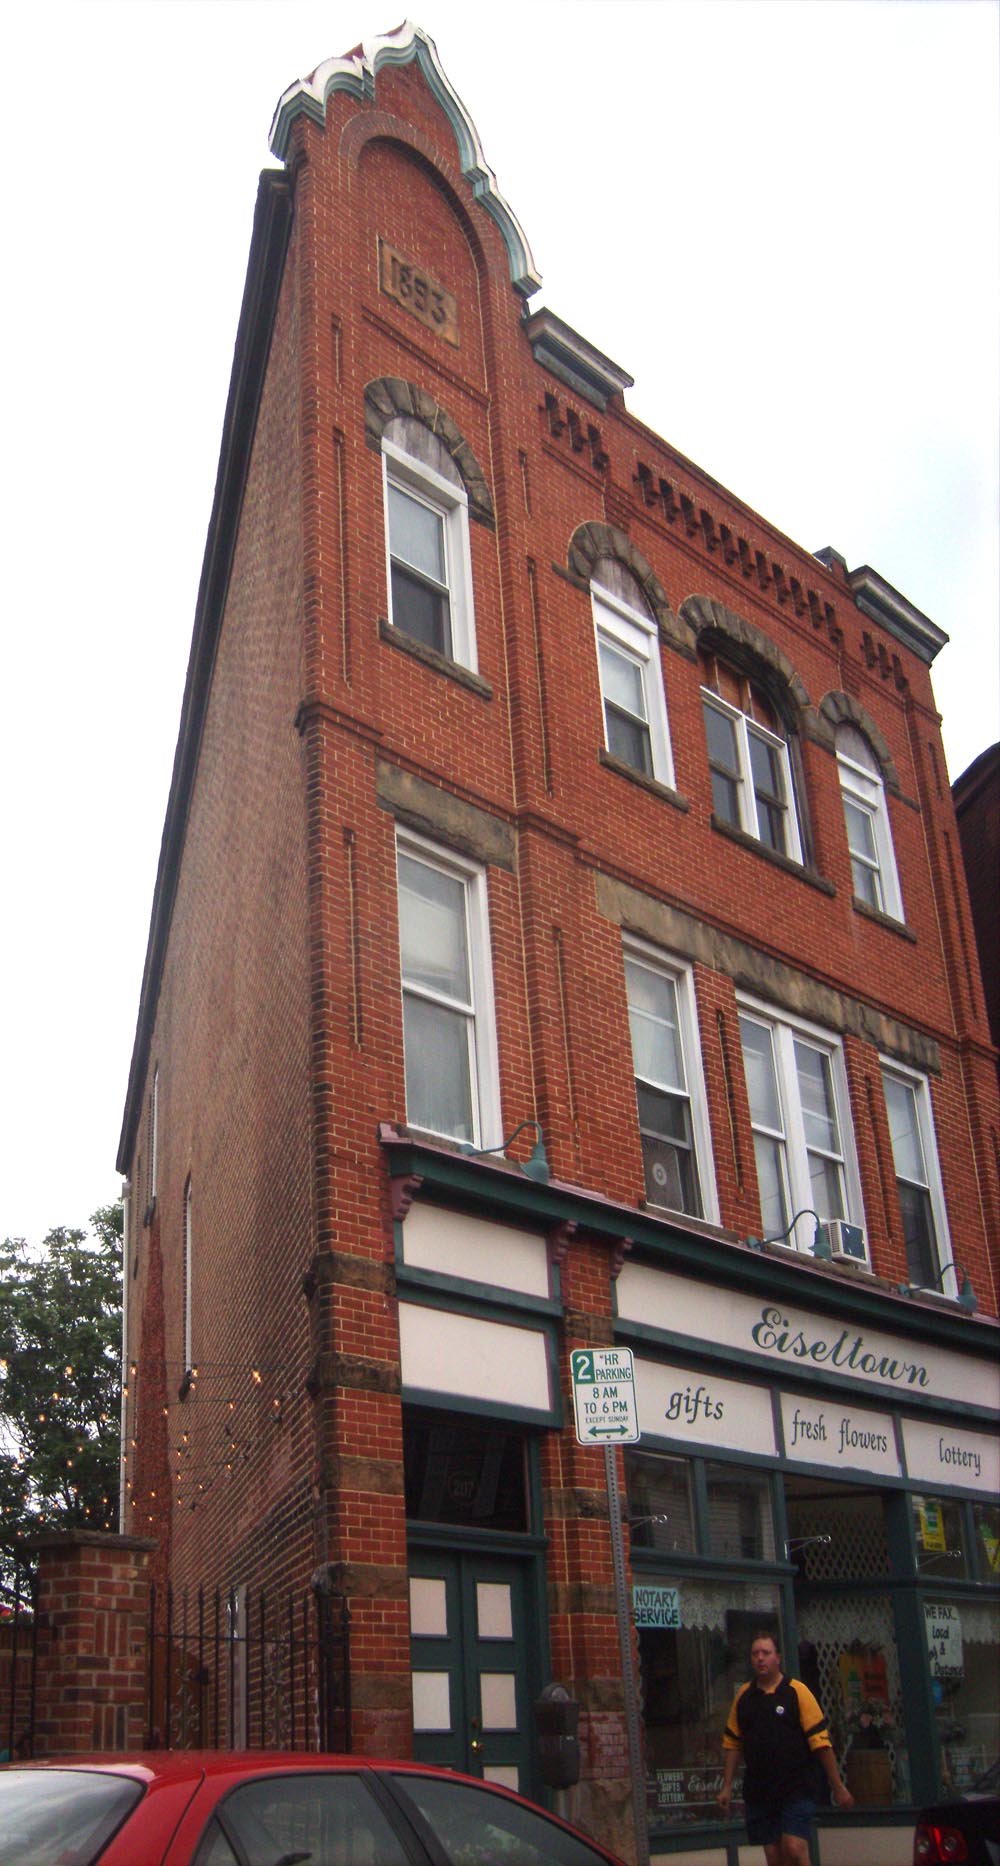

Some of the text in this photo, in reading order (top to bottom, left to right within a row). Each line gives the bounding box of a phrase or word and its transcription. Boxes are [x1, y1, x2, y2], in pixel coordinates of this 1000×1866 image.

[390, 256, 446, 325] 1853
[751, 1307, 930, 1387] Eiseltown
[576, 1355, 592, 1380] 2
[604, 1353, 619, 1366] HR
[595, 1367, 632, 1381] PARKING
[592, 1386, 618, 1399] 8 AM
[584, 1400, 628, 1414] TO 6 PM
[665, 1386, 724, 1424] gifts
[585, 1414, 629, 1424] EXCEPT SUNDAY
[791, 1409, 887, 1454] fresh flowers
[938, 1437, 981, 1477] lottery
[635, 1589, 676, 1608] NOTARY
[634, 1607, 679, 1626] SERVICE
[925, 1606, 937, 1619] WE
